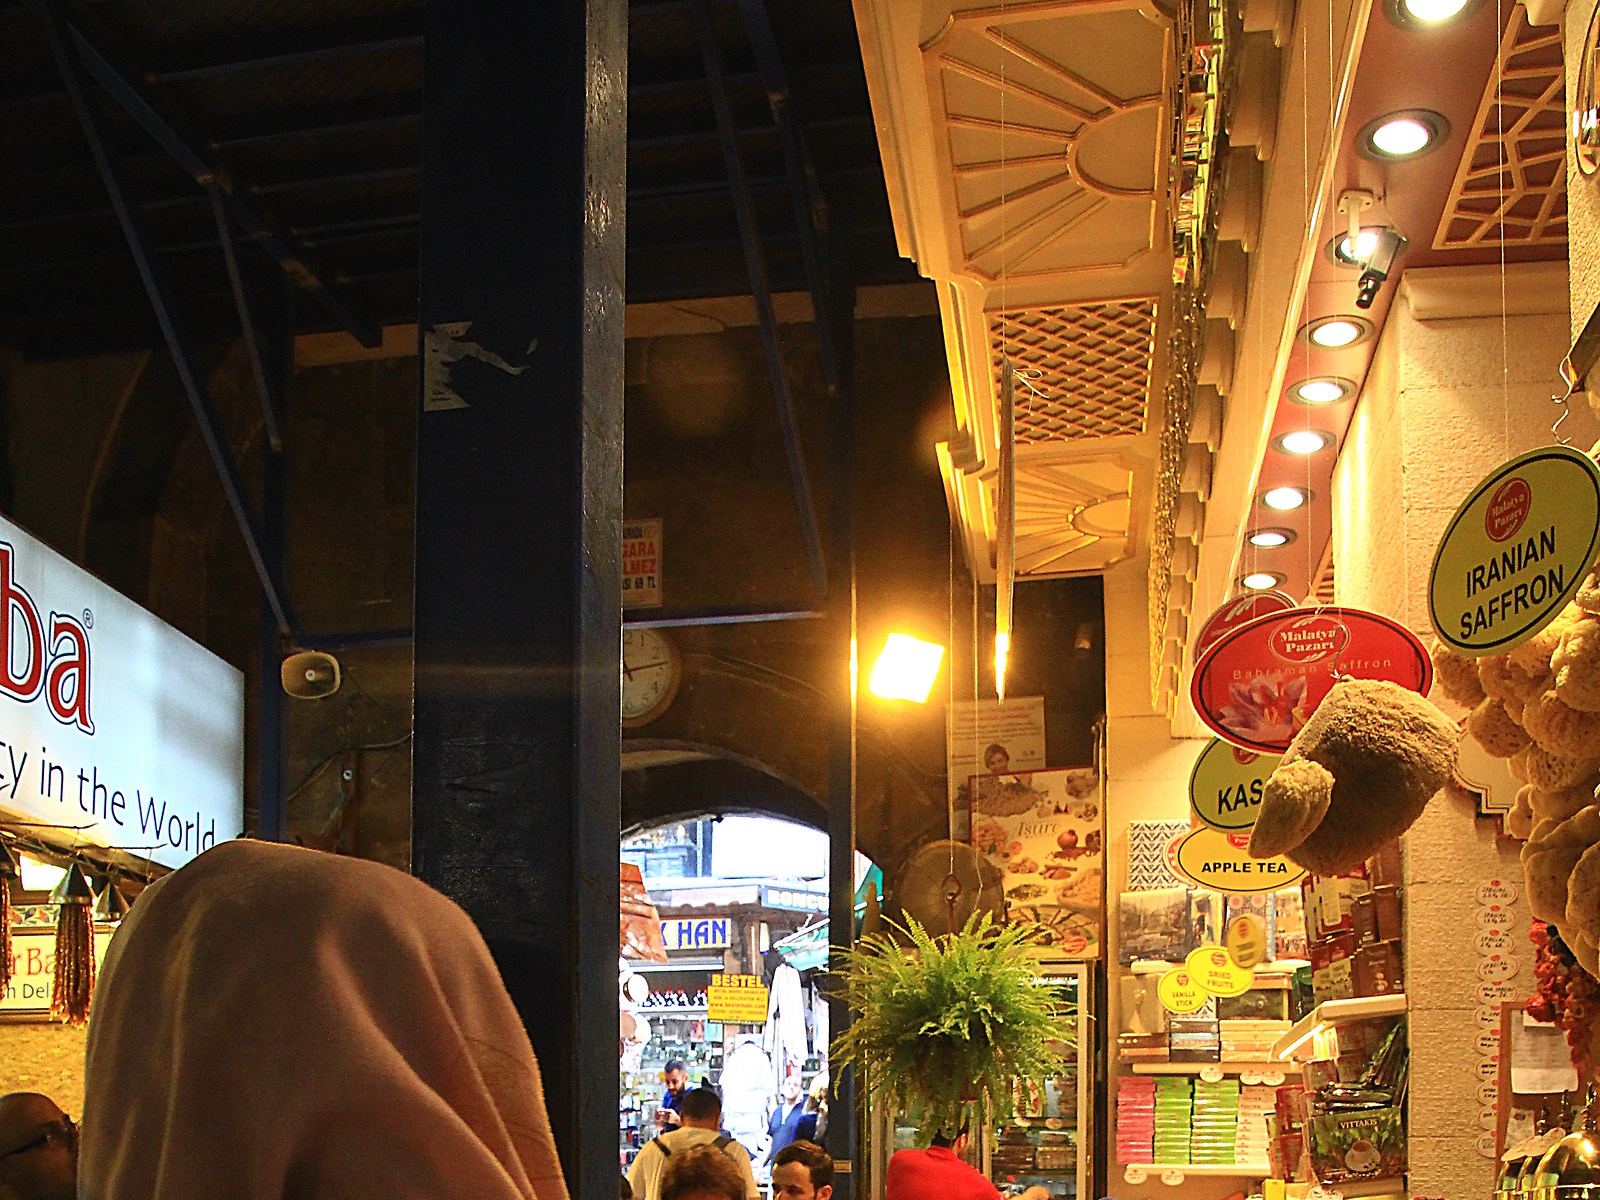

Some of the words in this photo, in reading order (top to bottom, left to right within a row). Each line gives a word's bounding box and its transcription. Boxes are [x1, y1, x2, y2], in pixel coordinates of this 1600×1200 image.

[1467, 526, 1555, 597] IRANIAN
[1460, 564, 1564, 639] SAFFRON
[1281, 628, 1337, 642] Malatya
[1232, 664, 1318, 680] Bahraman
[1327, 659, 1392, 673] Saffron
[41, 746, 64, 802] in
[77, 766, 126, 826] the
[137, 790, 215, 854] World
[1218, 779, 1263, 815] KAS
[1202, 863, 1251, 873] APPLE
[1257, 863, 1287, 873] TEA
[677, 919, 726, 948] HAN
[711, 973, 765, 988] BESTEL
[1208, 970, 1231, 979] DRIED
[1207, 979, 1234, 989] FRUITS
[1340, 1118, 1378, 1129] VITTAKIS
